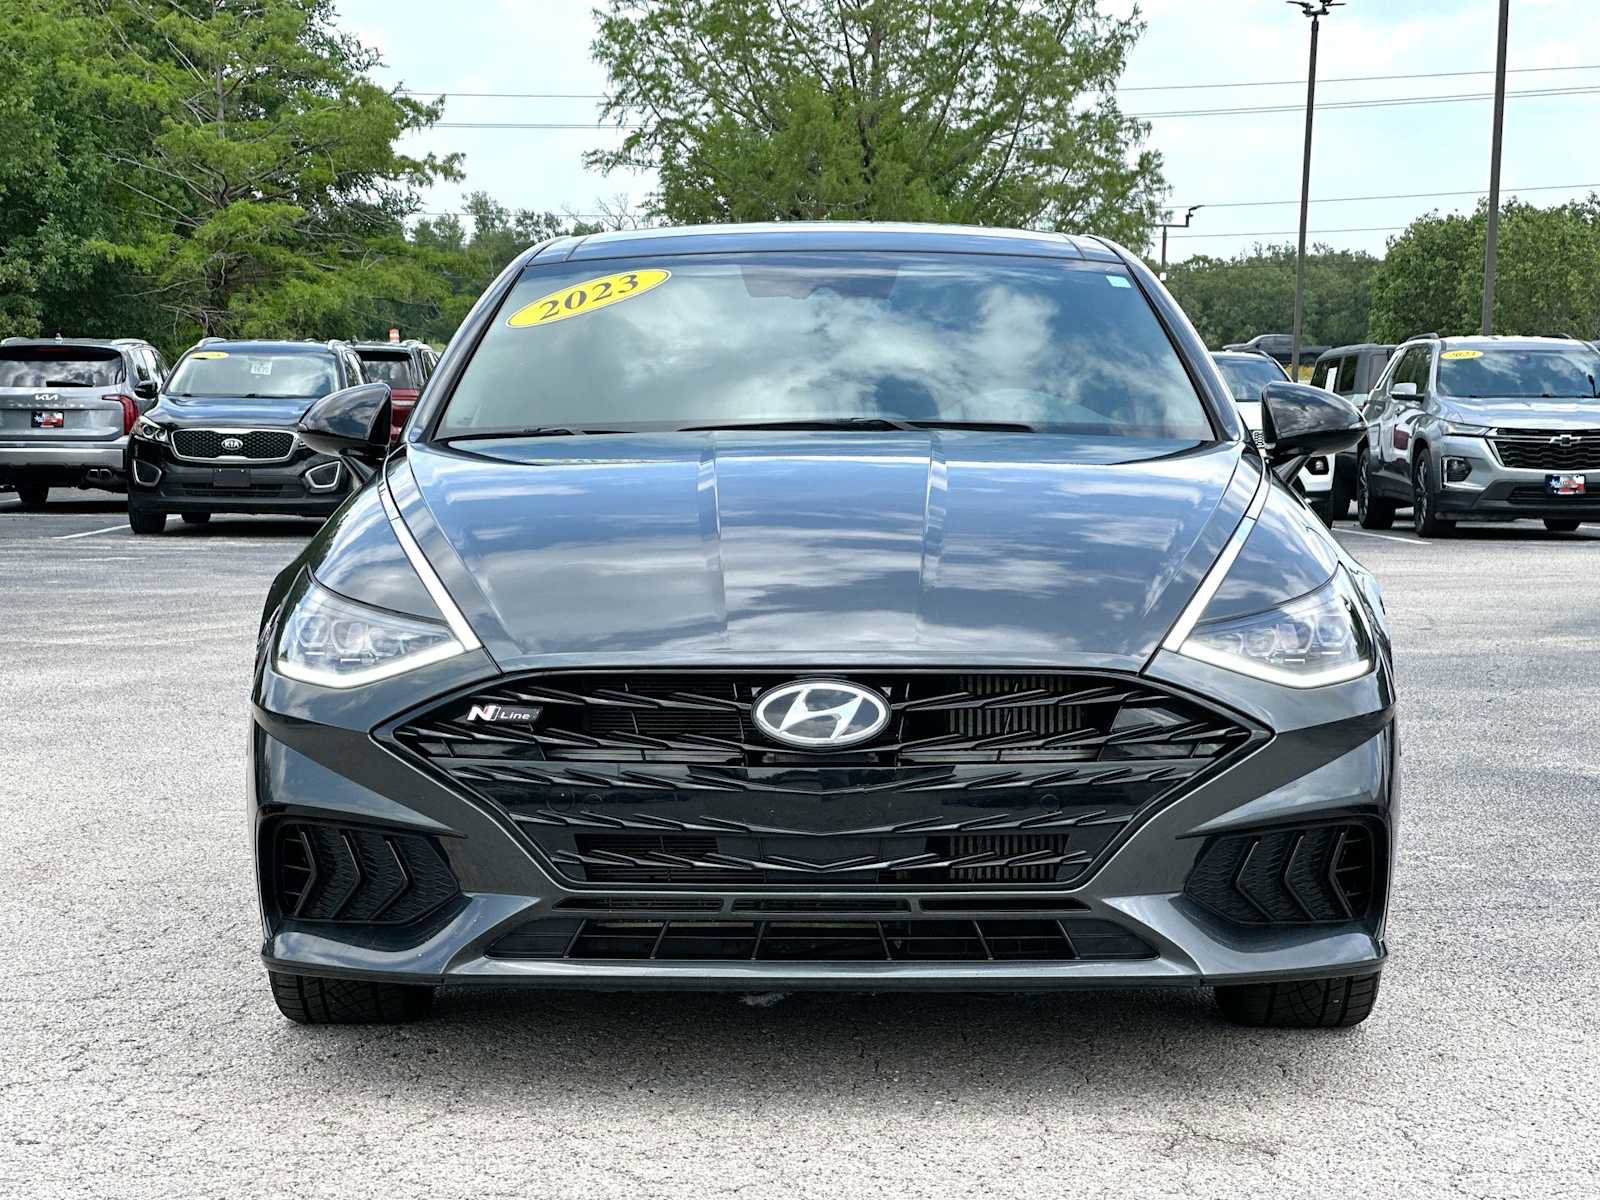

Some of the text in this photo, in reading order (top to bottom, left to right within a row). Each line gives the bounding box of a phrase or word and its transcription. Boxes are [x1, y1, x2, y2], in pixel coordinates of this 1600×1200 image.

[540, 274, 639, 320] 2023
[224, 440, 240, 448] KIA
[500, 711, 530, 720] Line
